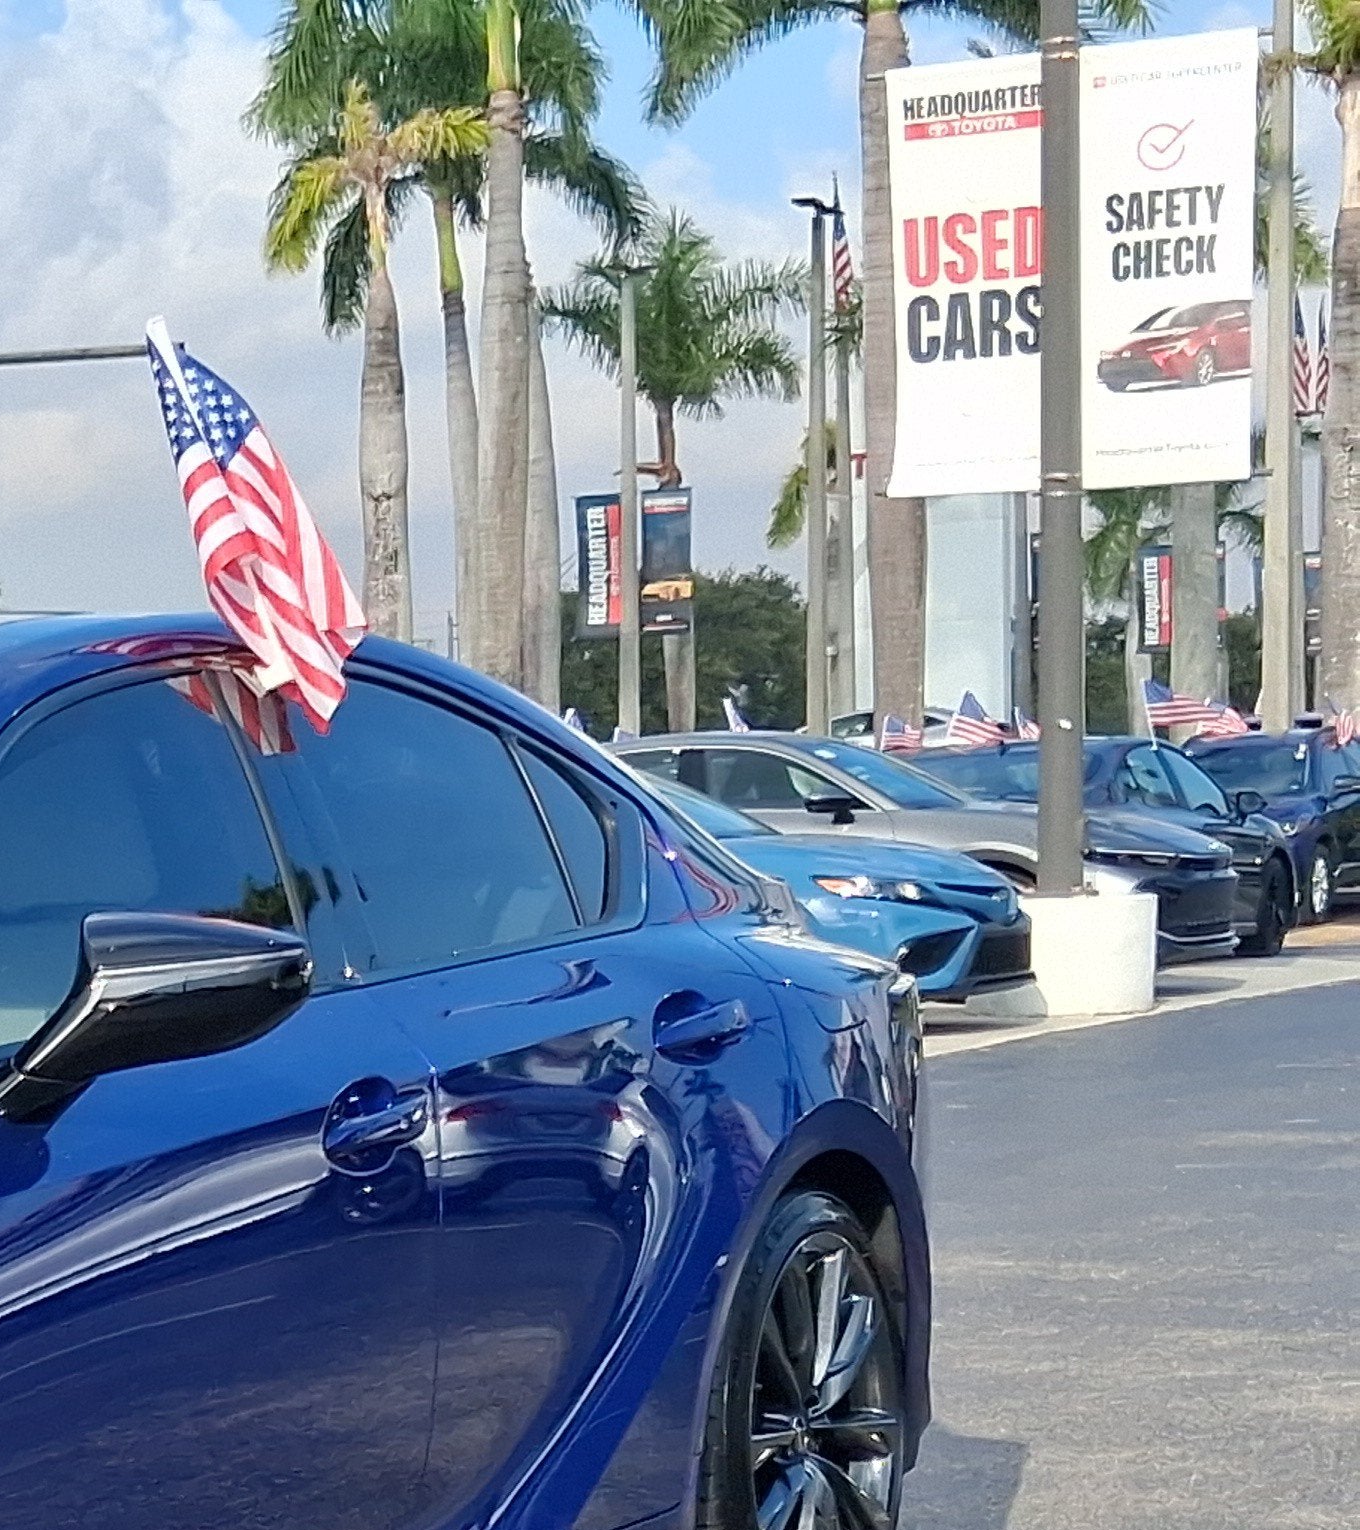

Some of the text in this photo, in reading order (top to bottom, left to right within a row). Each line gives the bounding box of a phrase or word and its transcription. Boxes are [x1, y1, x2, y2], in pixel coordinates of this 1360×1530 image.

[902, 84, 1042, 120] HEADQUARTER
[951, 115, 1017, 137] TOYOTA
[1105, 183, 1225, 234] SAFETY
[902, 206, 1043, 287] USED
[1111, 234, 1218, 283] CHECK
[907, 285, 1043, 364] CARS
